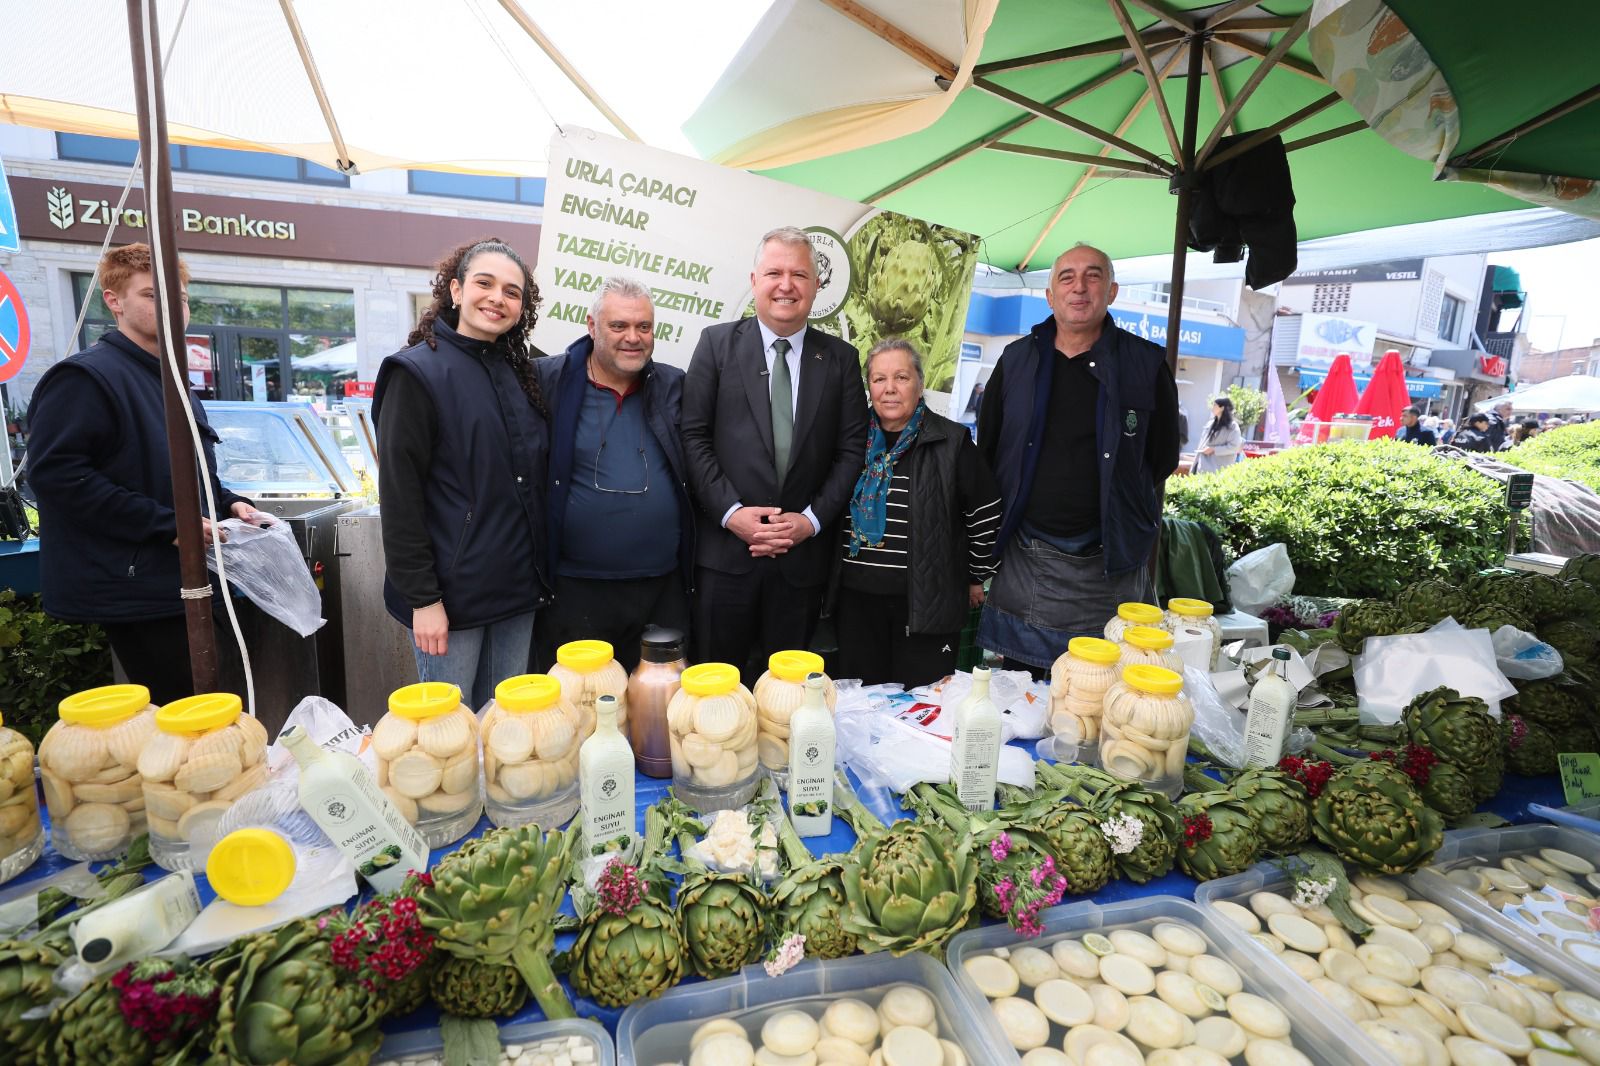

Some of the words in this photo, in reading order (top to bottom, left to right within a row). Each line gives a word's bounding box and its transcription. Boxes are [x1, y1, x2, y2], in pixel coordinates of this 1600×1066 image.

[565, 157, 614, 188] URLA
[618, 172, 698, 208] ÇAPACI
[79, 199, 178, 230] Zira
[182, 208, 297, 240] Bankası
[560, 193, 650, 231] ENGİNAR
[808, 235, 834, 248] URLA
[555, 232, 664, 273] TAZELİĞİYLE
[664, 257, 714, 285] FARK
[1386, 271, 1418, 280] VESTEL
[650, 286, 724, 319] EZZETİYLE
[1151, 325, 1202, 345] BAKASI
[796, 777, 825, 785] ENGİNAR
[593, 810, 626, 823] ENGİNAR
[600, 820, 620, 831] SUYU
[341, 824, 376, 847] ENGİNAR
[354, 835, 376, 851] SUYU
